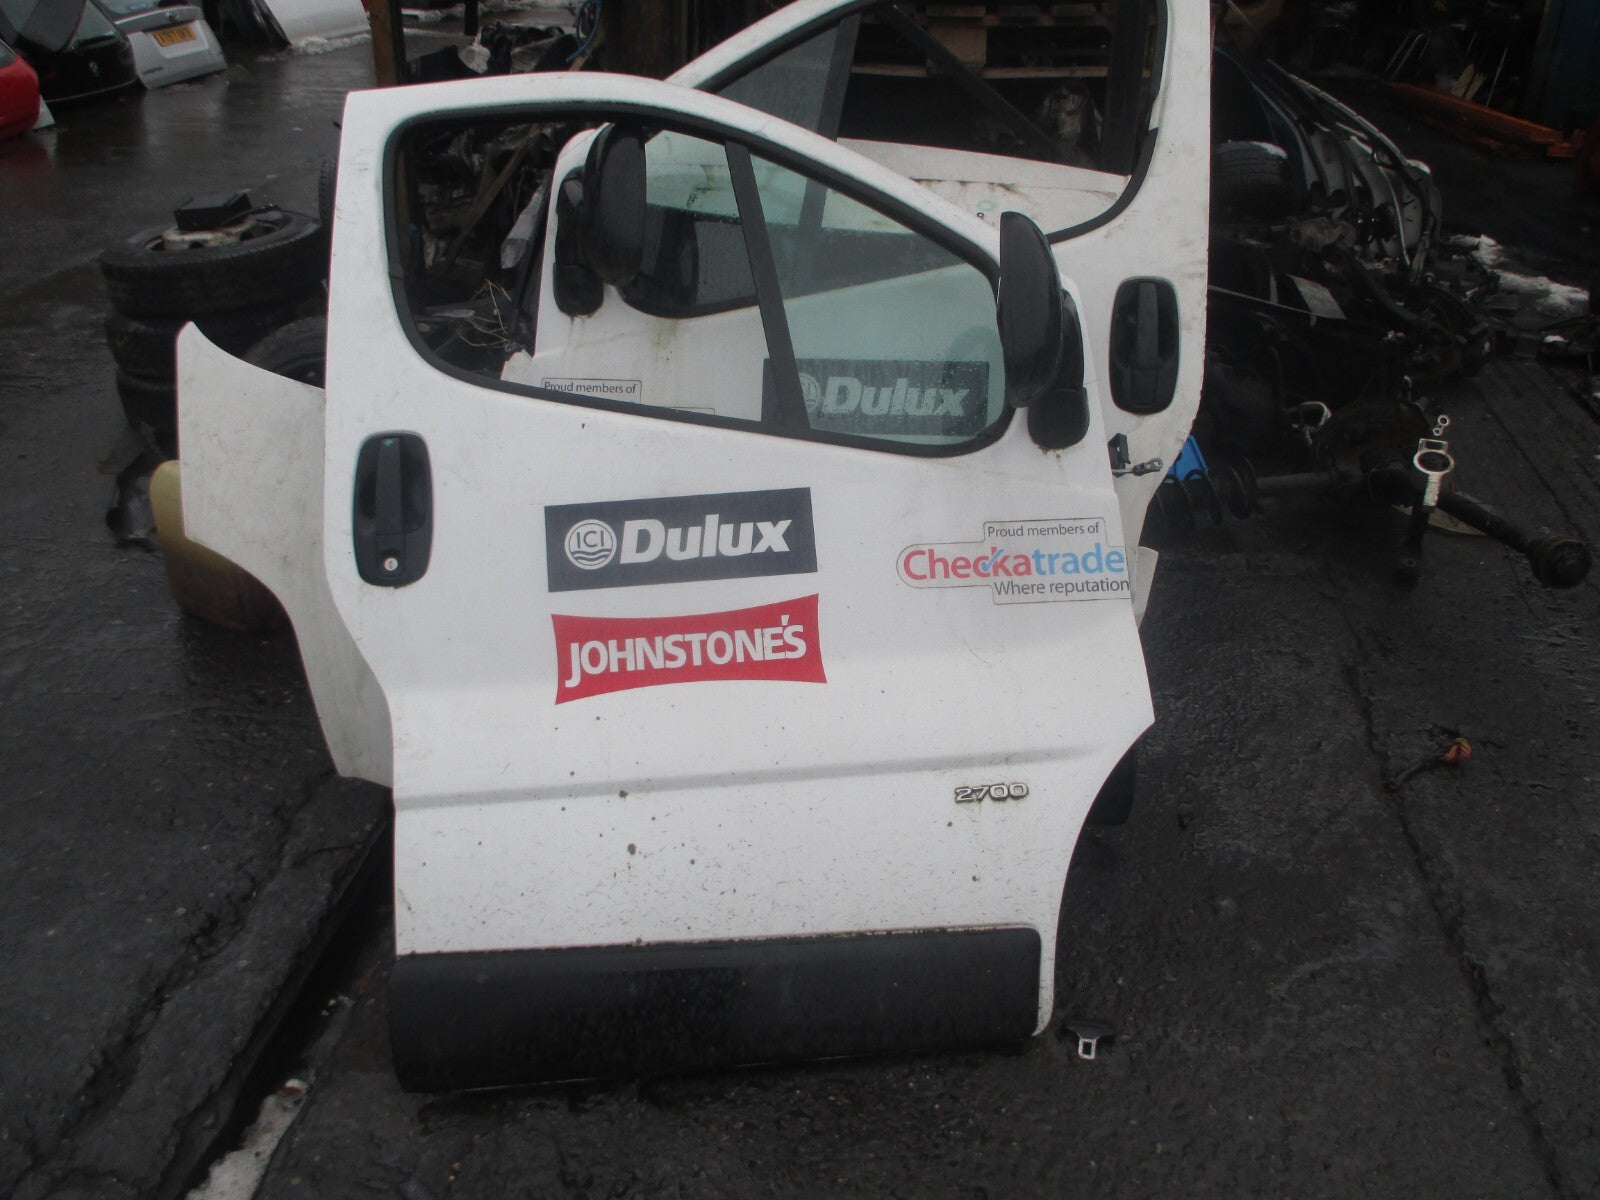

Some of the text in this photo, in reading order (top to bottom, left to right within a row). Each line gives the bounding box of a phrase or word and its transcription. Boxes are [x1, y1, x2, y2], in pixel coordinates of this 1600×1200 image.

[544, 381, 638, 394] Proud members of
[821, 376, 970, 416] Dulux
[576, 513, 793, 564] ICI Dulux
[988, 522, 1100, 538] Proud members of
[903, 542, 1125, 580] Checkatrade
[993, 578, 1130, 597] Where reputation
[565, 614, 807, 688] JOHNSTONE'S
[954, 783, 1029, 804] 2700
